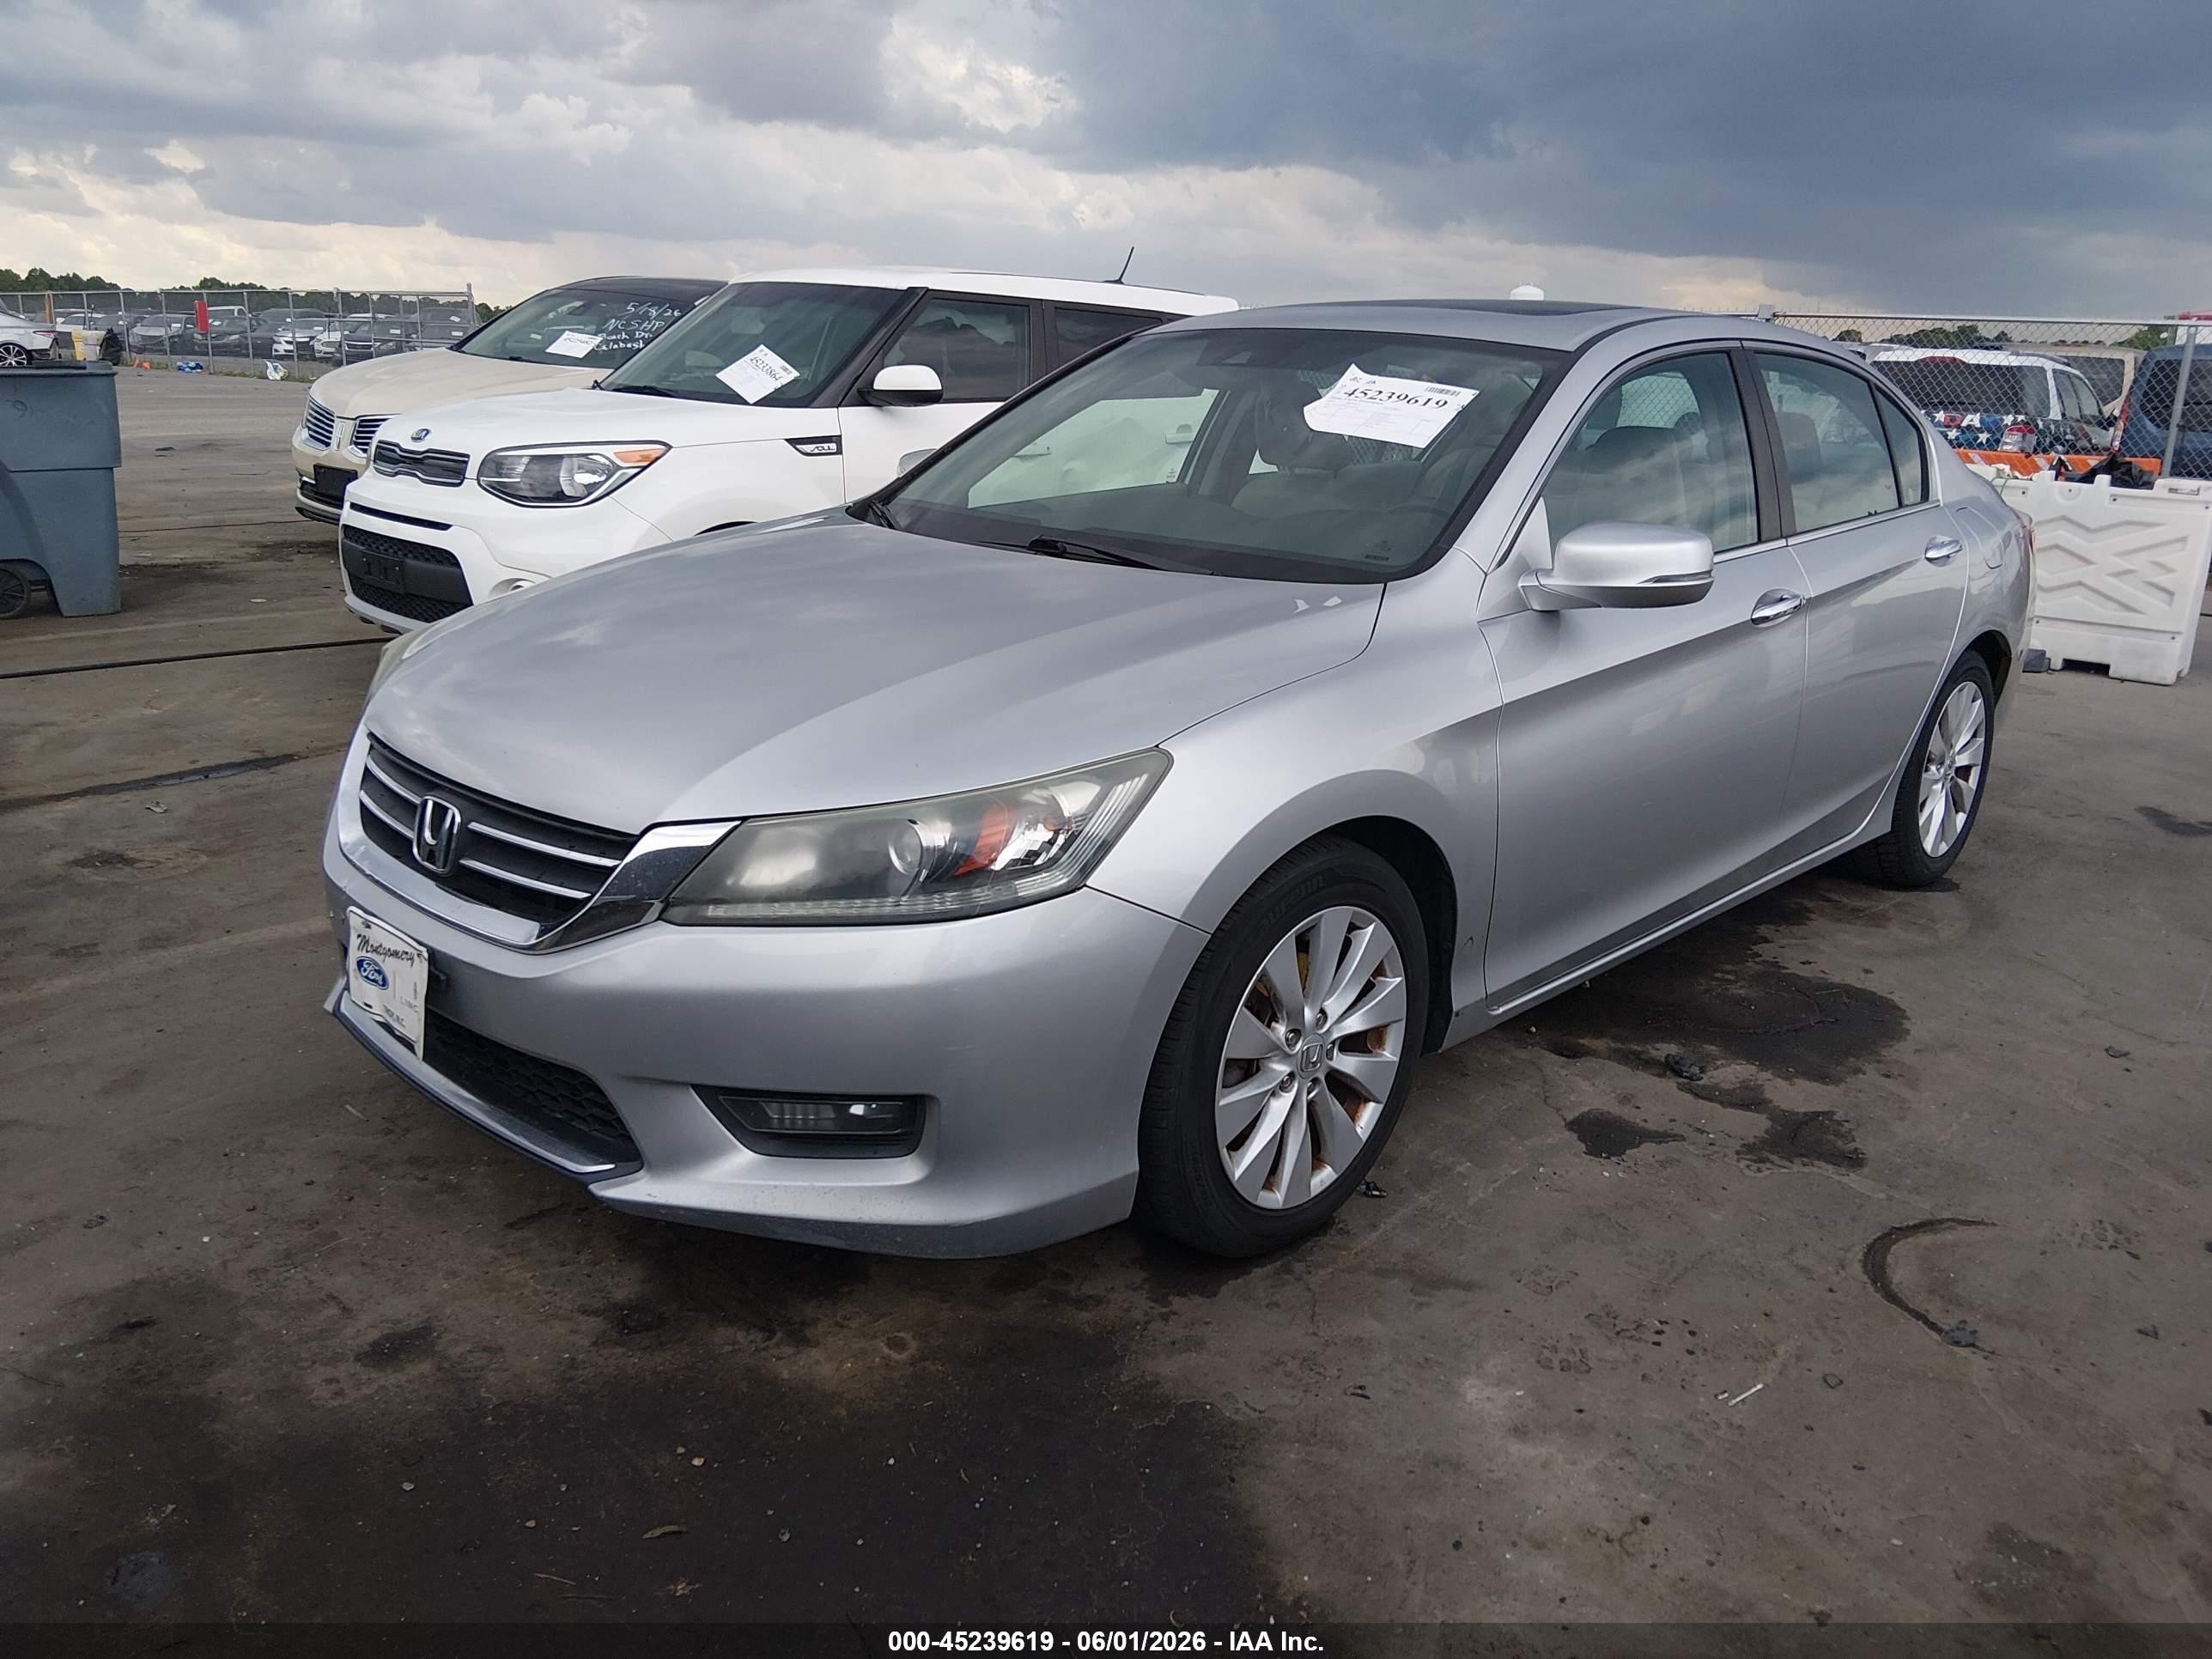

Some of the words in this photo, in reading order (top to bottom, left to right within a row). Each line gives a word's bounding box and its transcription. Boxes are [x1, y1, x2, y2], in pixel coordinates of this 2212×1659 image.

[1343, 387, 1449, 410] 45239619
[356, 933, 415, 968] Montgomery
[359, 958, 386, 985] Ford
